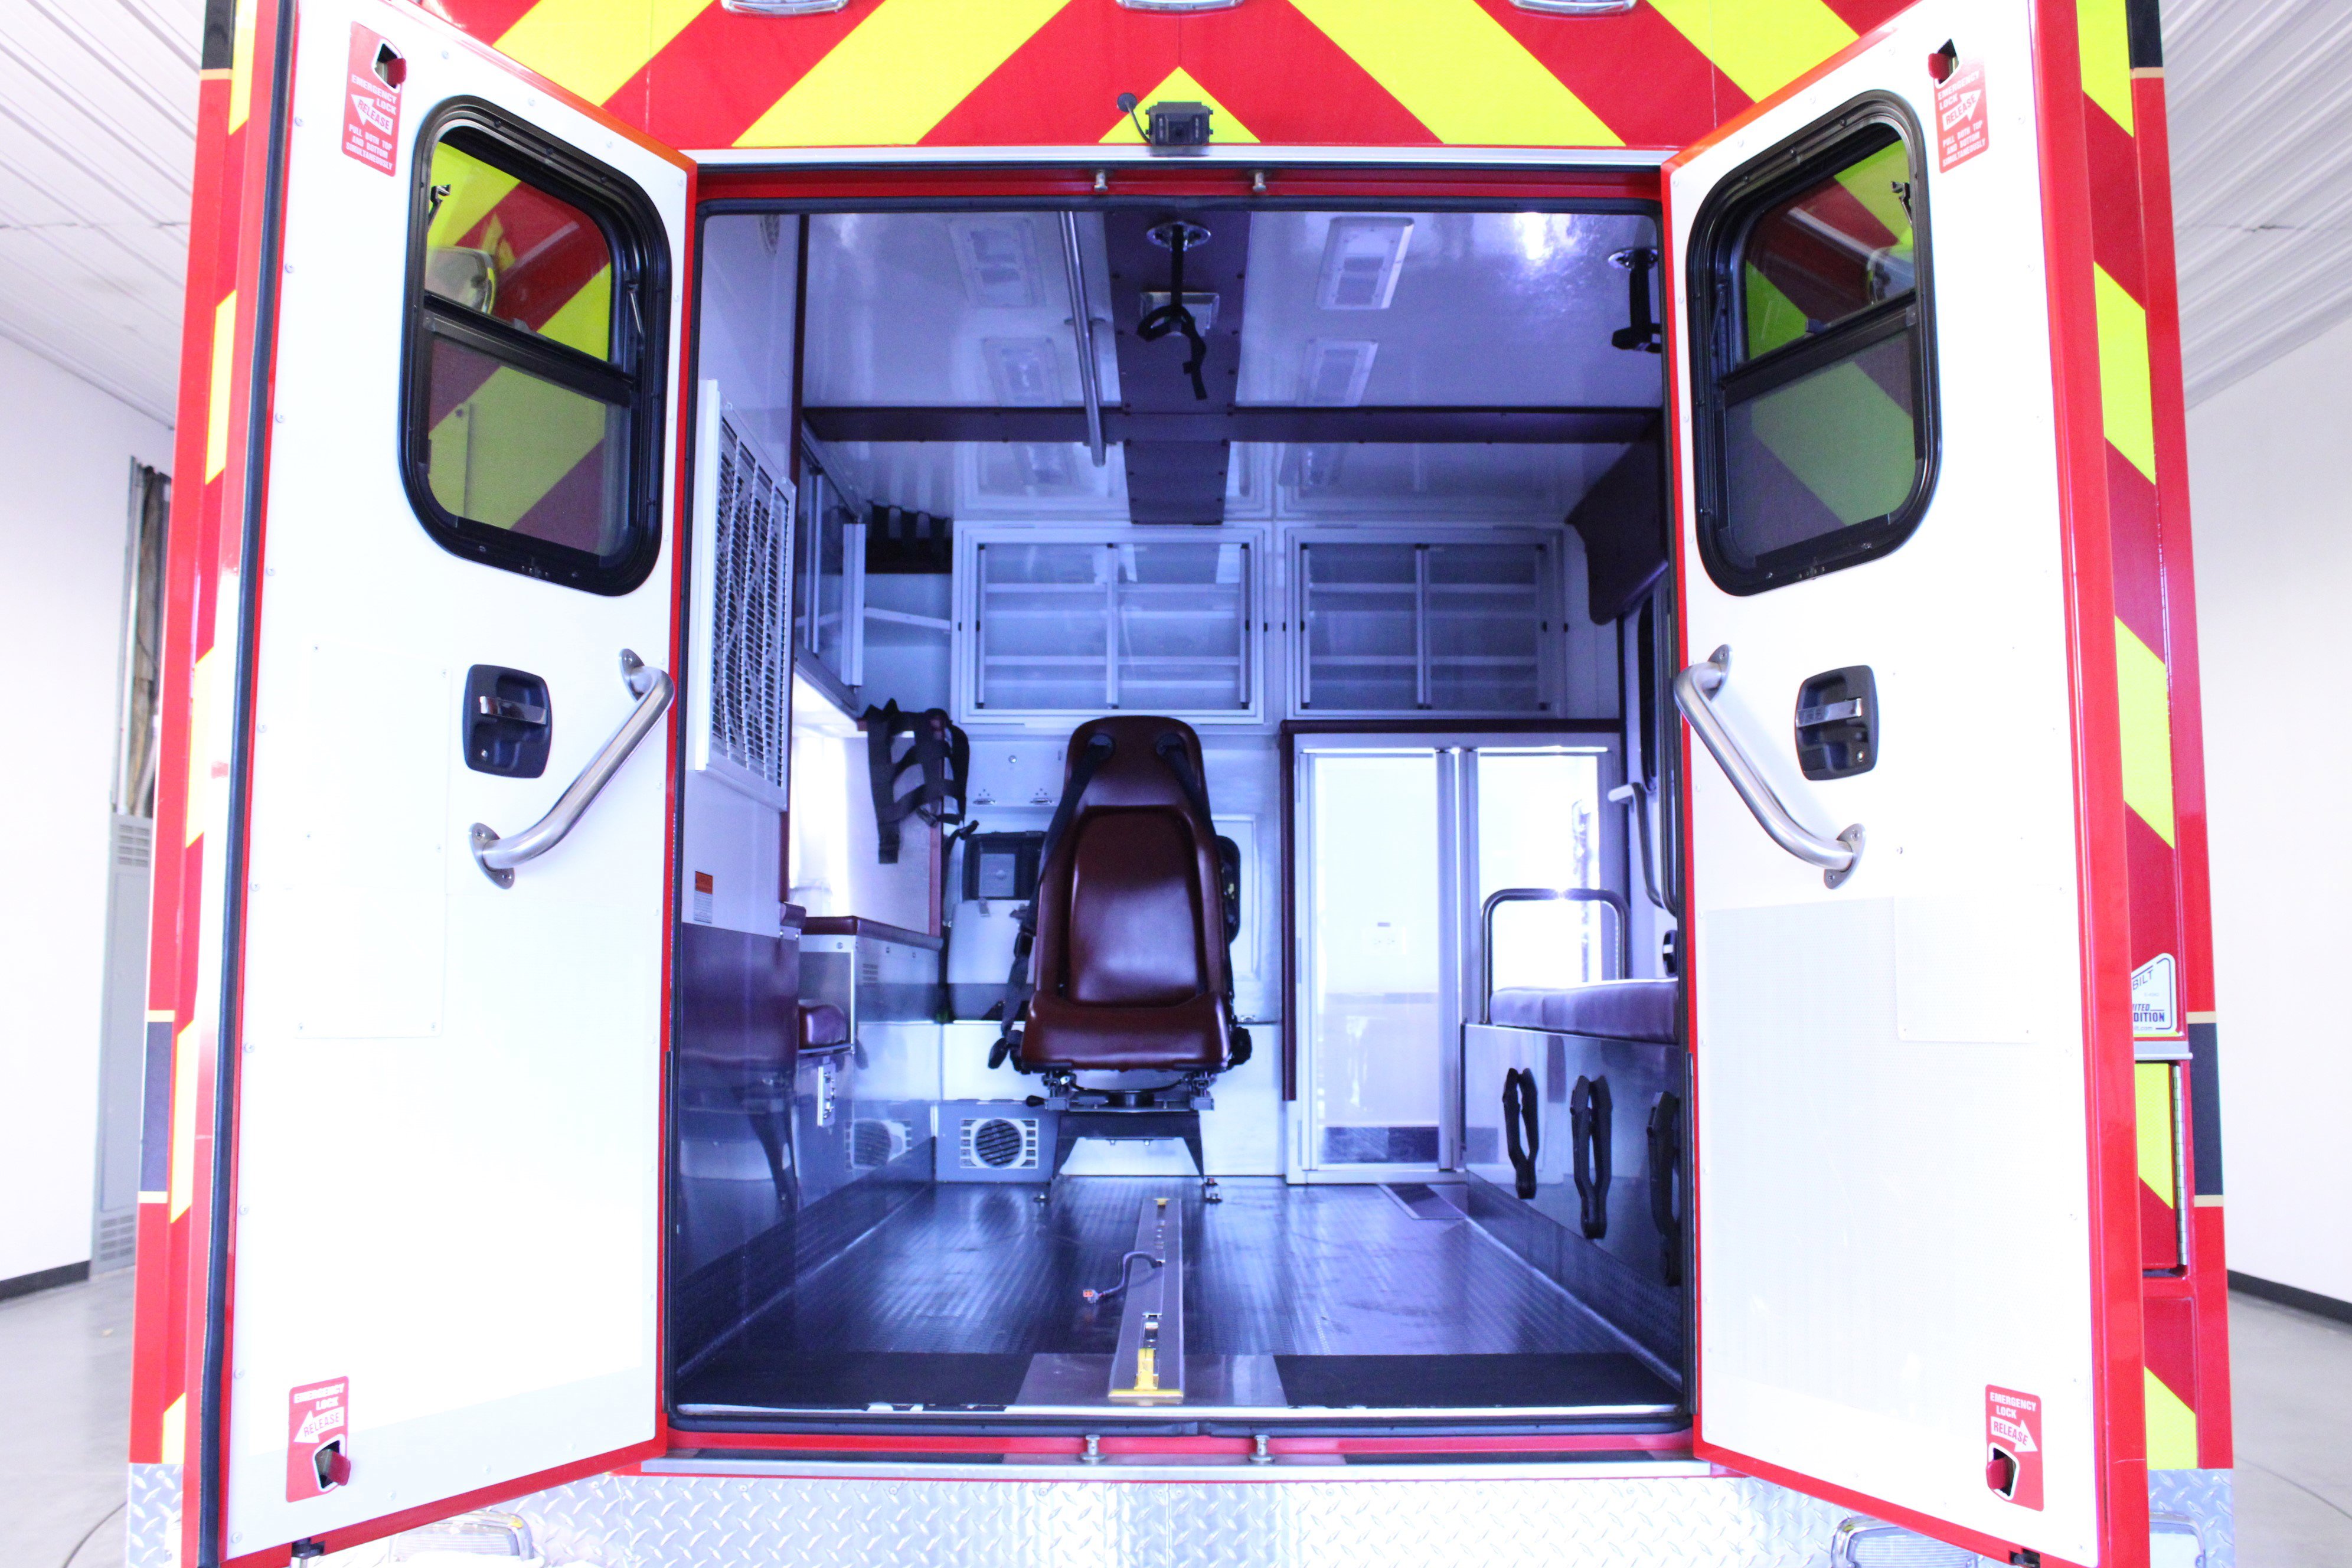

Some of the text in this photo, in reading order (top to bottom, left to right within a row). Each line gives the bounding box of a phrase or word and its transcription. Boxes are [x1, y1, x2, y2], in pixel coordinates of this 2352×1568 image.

[352, 74, 397, 104] EMERGENCY
[1938, 71, 1980, 100] EMERGENCY
[358, 99, 390, 130] RELEASE
[377, 99, 397, 116] LOCK
[1940, 94, 1958, 111] LOCK
[1946, 94, 1976, 125] RELEASE
[349, 124, 393, 151] PULL BOTH TOP
[1943, 120, 1983, 148] PULL BOTH TOP
[1947, 132, 1980, 155] AND BOTTOM
[346, 142, 393, 170] SIMULTANEOUSLY
[352, 136, 388, 159] AND BOTTOM
[1943, 138, 1986, 168] SIMULTANEOUSLY
[294, 1383, 345, 1404] EMERGENCY
[316, 1397, 339, 1411] LOCK
[1990, 1392, 2037, 1412] EMERGENCY
[1997, 1405, 2017, 1419] LOCK
[304, 1412, 340, 1438] RELEASE
[1994, 1422, 2028, 1446] RELEASE
